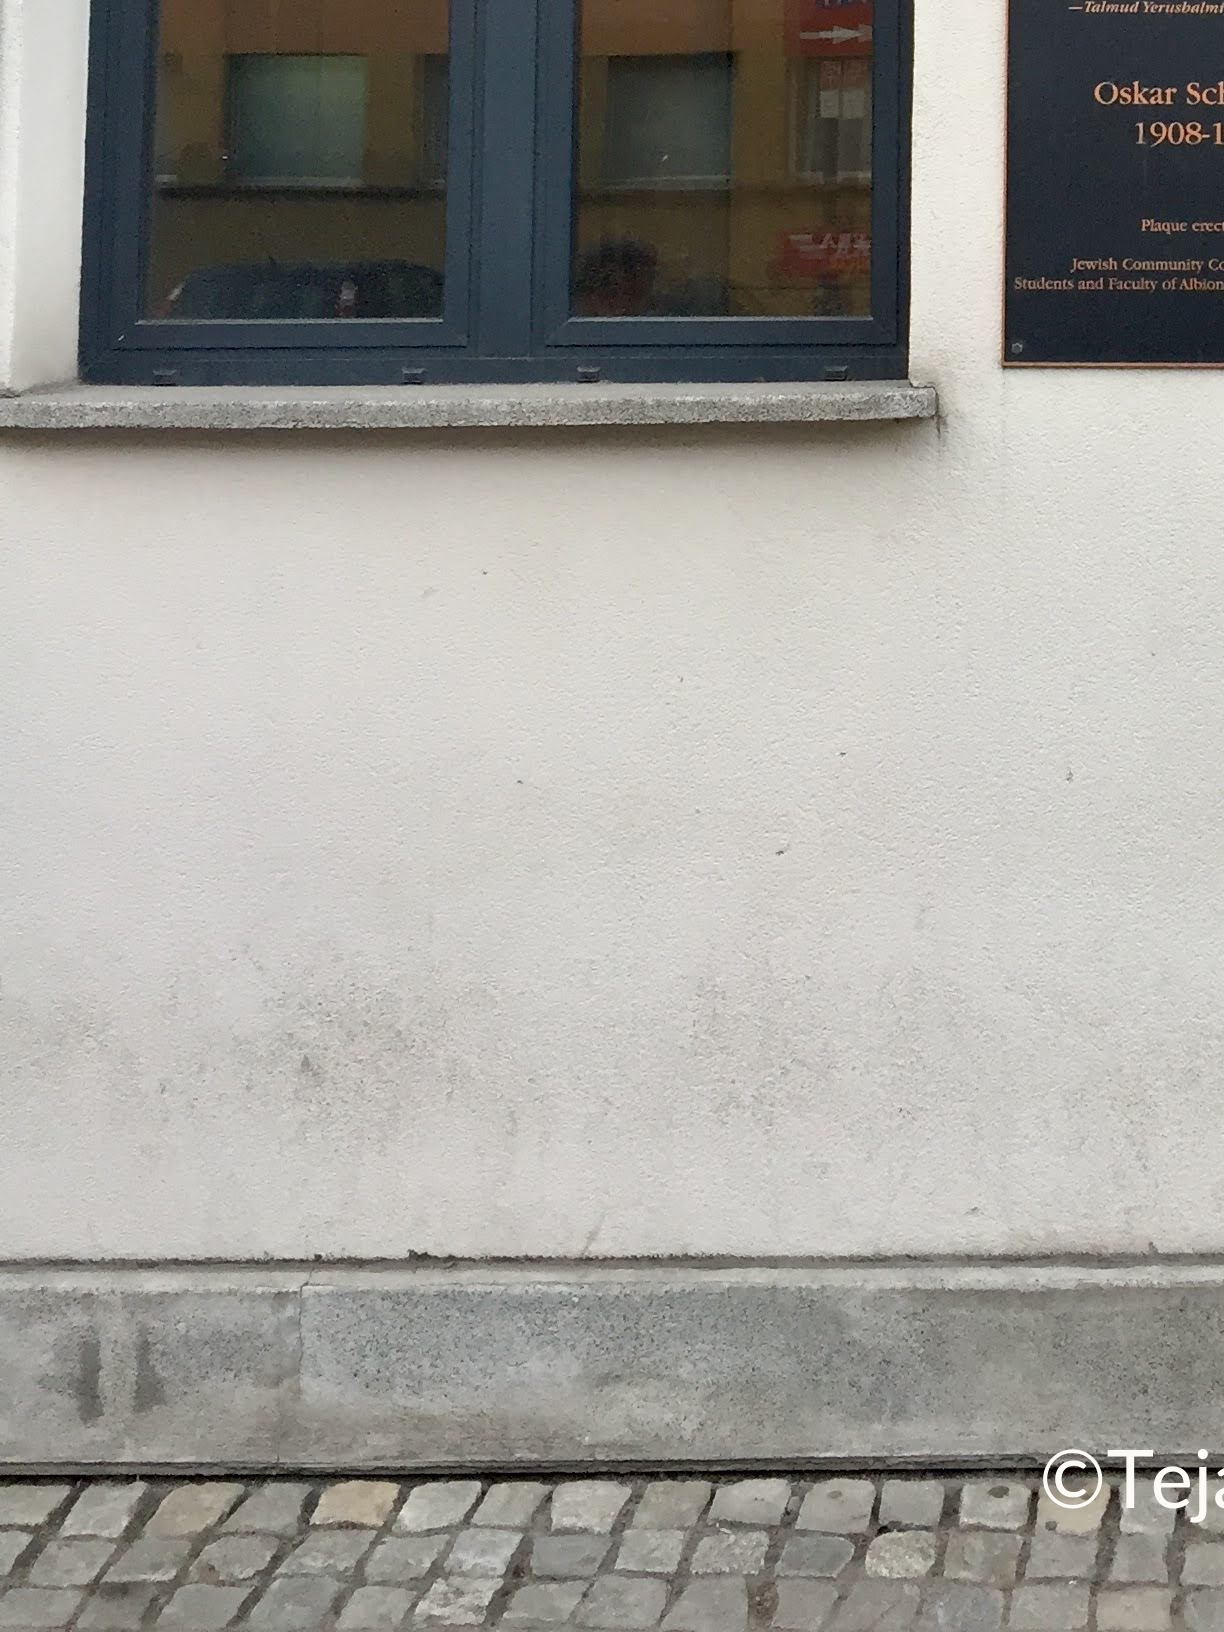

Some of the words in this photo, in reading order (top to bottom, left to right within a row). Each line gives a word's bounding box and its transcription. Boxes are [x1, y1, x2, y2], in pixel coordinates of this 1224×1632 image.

[1094, 81, 1177, 104] Oskar
[1141, 219, 1187, 235] Plaque
[1070, 257, 1117, 273] Jewish
[1122, 258, 1204, 274] Community
[1014, 277, 1074, 290] Students
[1078, 277, 1103, 290] and
[1108, 277, 1157, 292] Faculty
[1162, 277, 1178, 290] of
[1179, 278, 1224, 290] Albion
